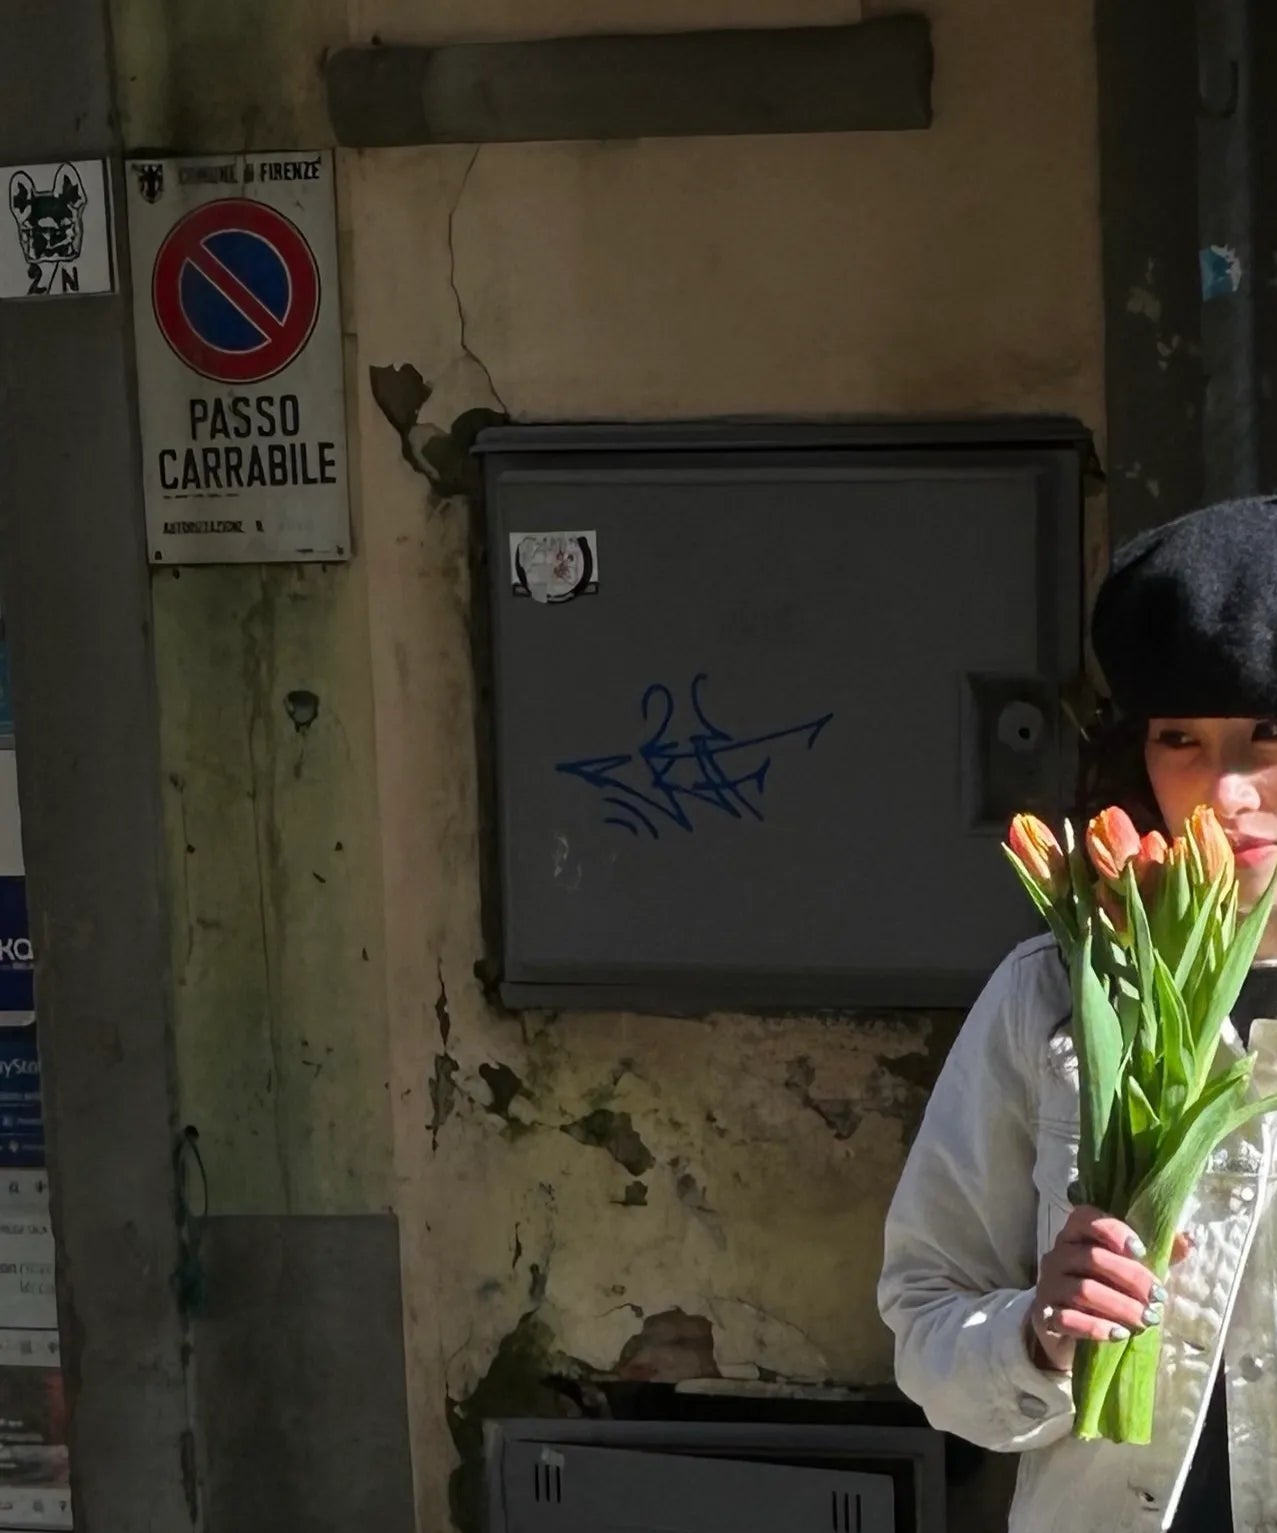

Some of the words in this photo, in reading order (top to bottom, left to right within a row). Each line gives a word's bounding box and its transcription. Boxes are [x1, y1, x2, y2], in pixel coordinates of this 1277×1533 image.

[260, 159, 321, 182] FIRENZE
[189, 394, 300, 440] PASSO
[158, 441, 337, 490] CARRABILE
